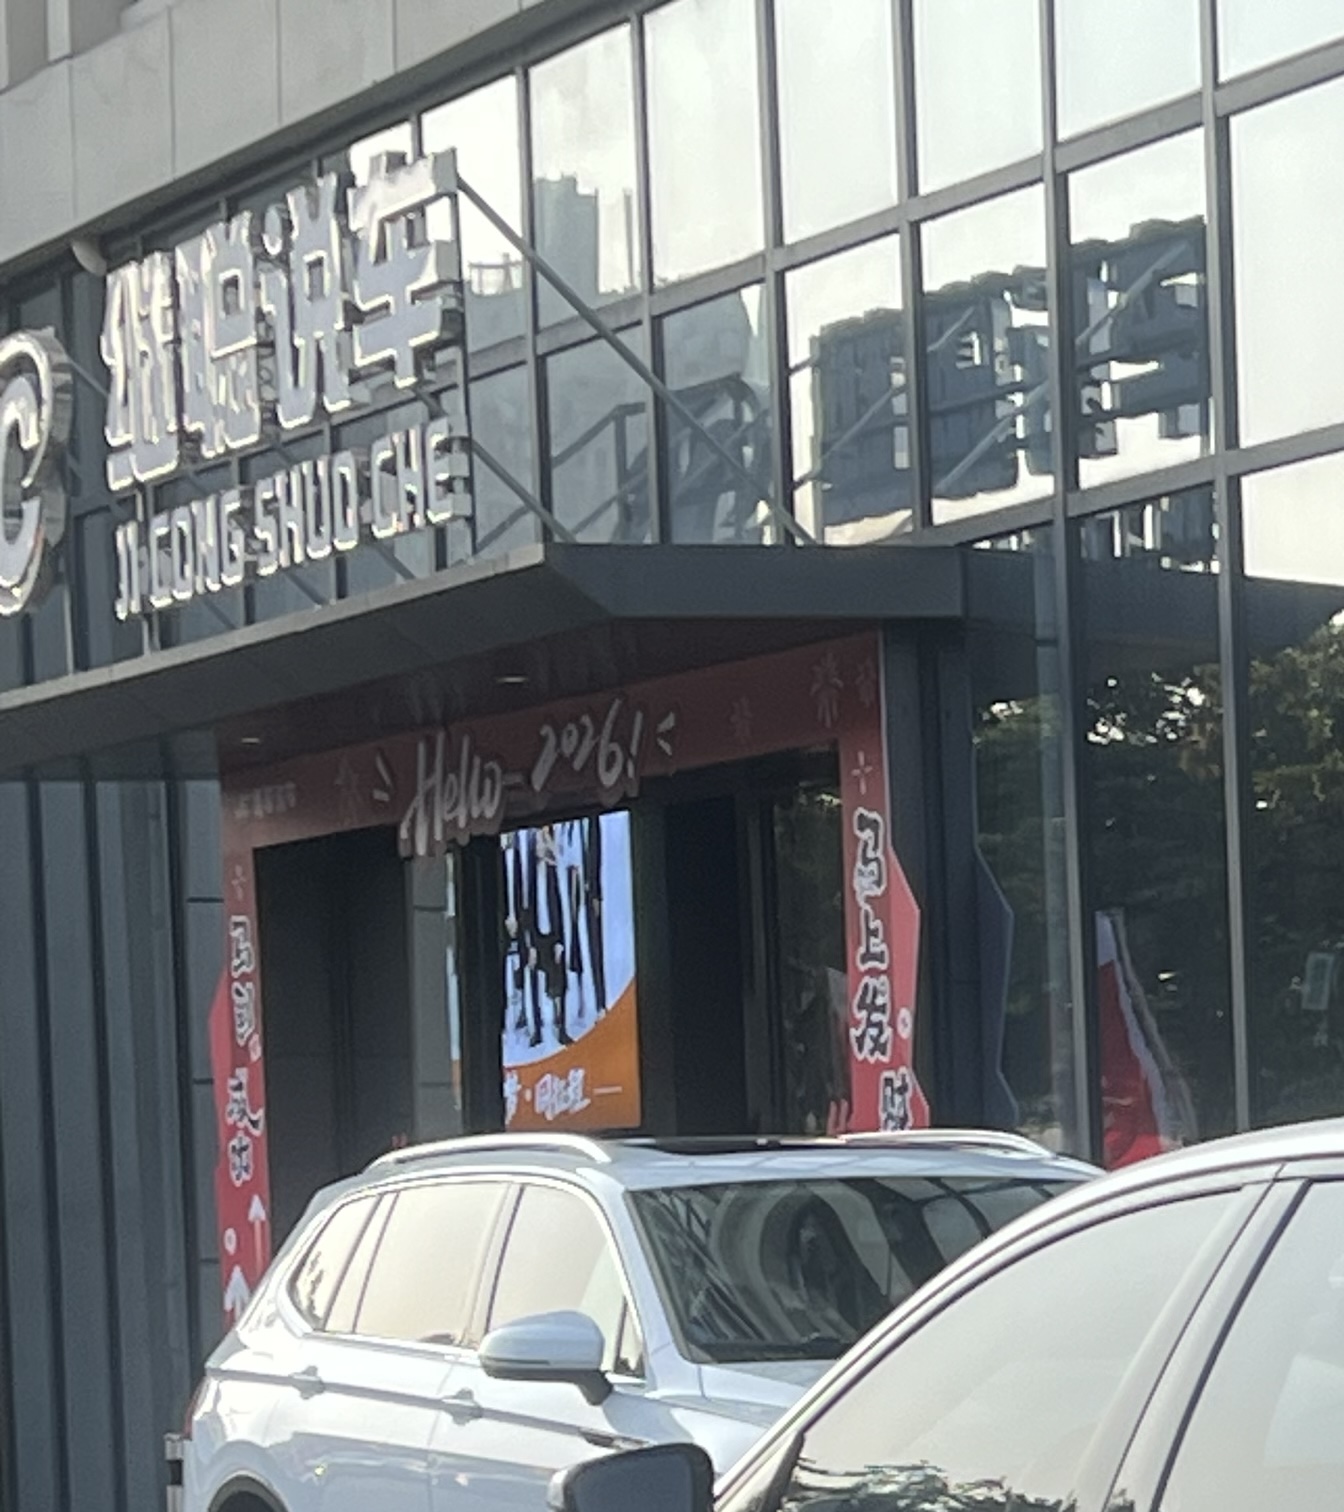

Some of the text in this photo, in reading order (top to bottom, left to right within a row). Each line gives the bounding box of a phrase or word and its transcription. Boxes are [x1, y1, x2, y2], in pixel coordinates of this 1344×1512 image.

[115, 520, 142, 620] JI
[254, 450, 359, 576] SHUO
[371, 417, 460, 540] CHE
[400, 730, 501, 856] Hello
